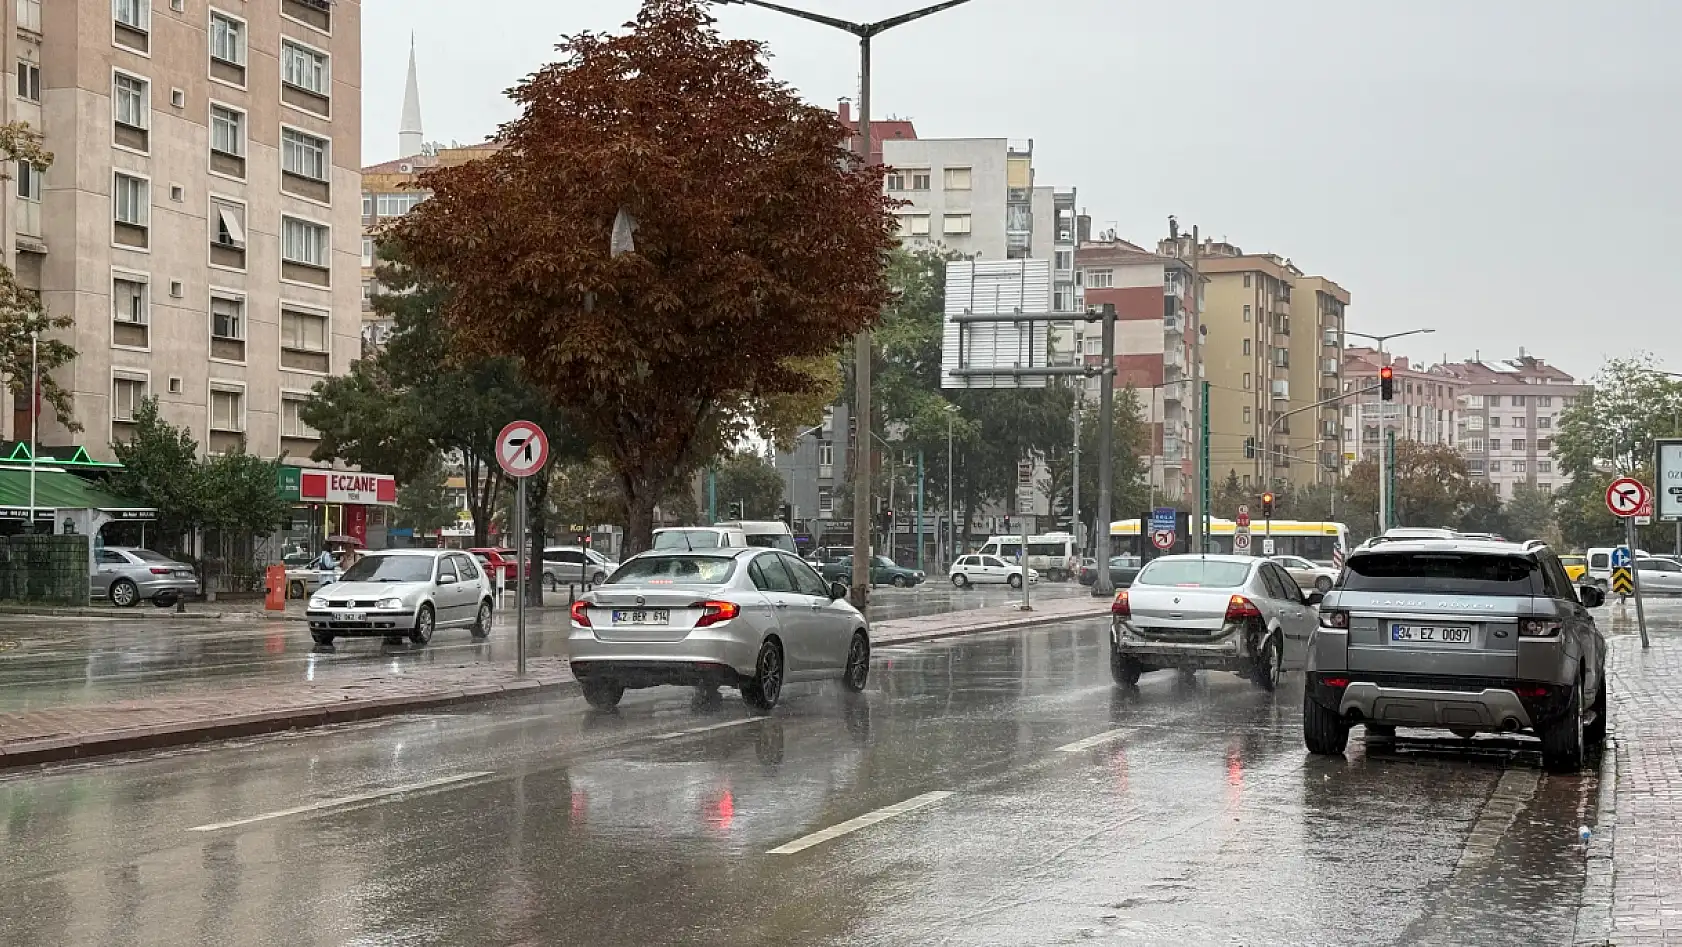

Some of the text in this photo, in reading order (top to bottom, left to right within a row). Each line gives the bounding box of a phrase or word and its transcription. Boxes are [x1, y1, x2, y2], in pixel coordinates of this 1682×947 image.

[331, 474, 376, 491] ECZANE
[617, 611, 667, 622] 42 BER 614
[1398, 627, 1469, 642] 34 EZ 0097
